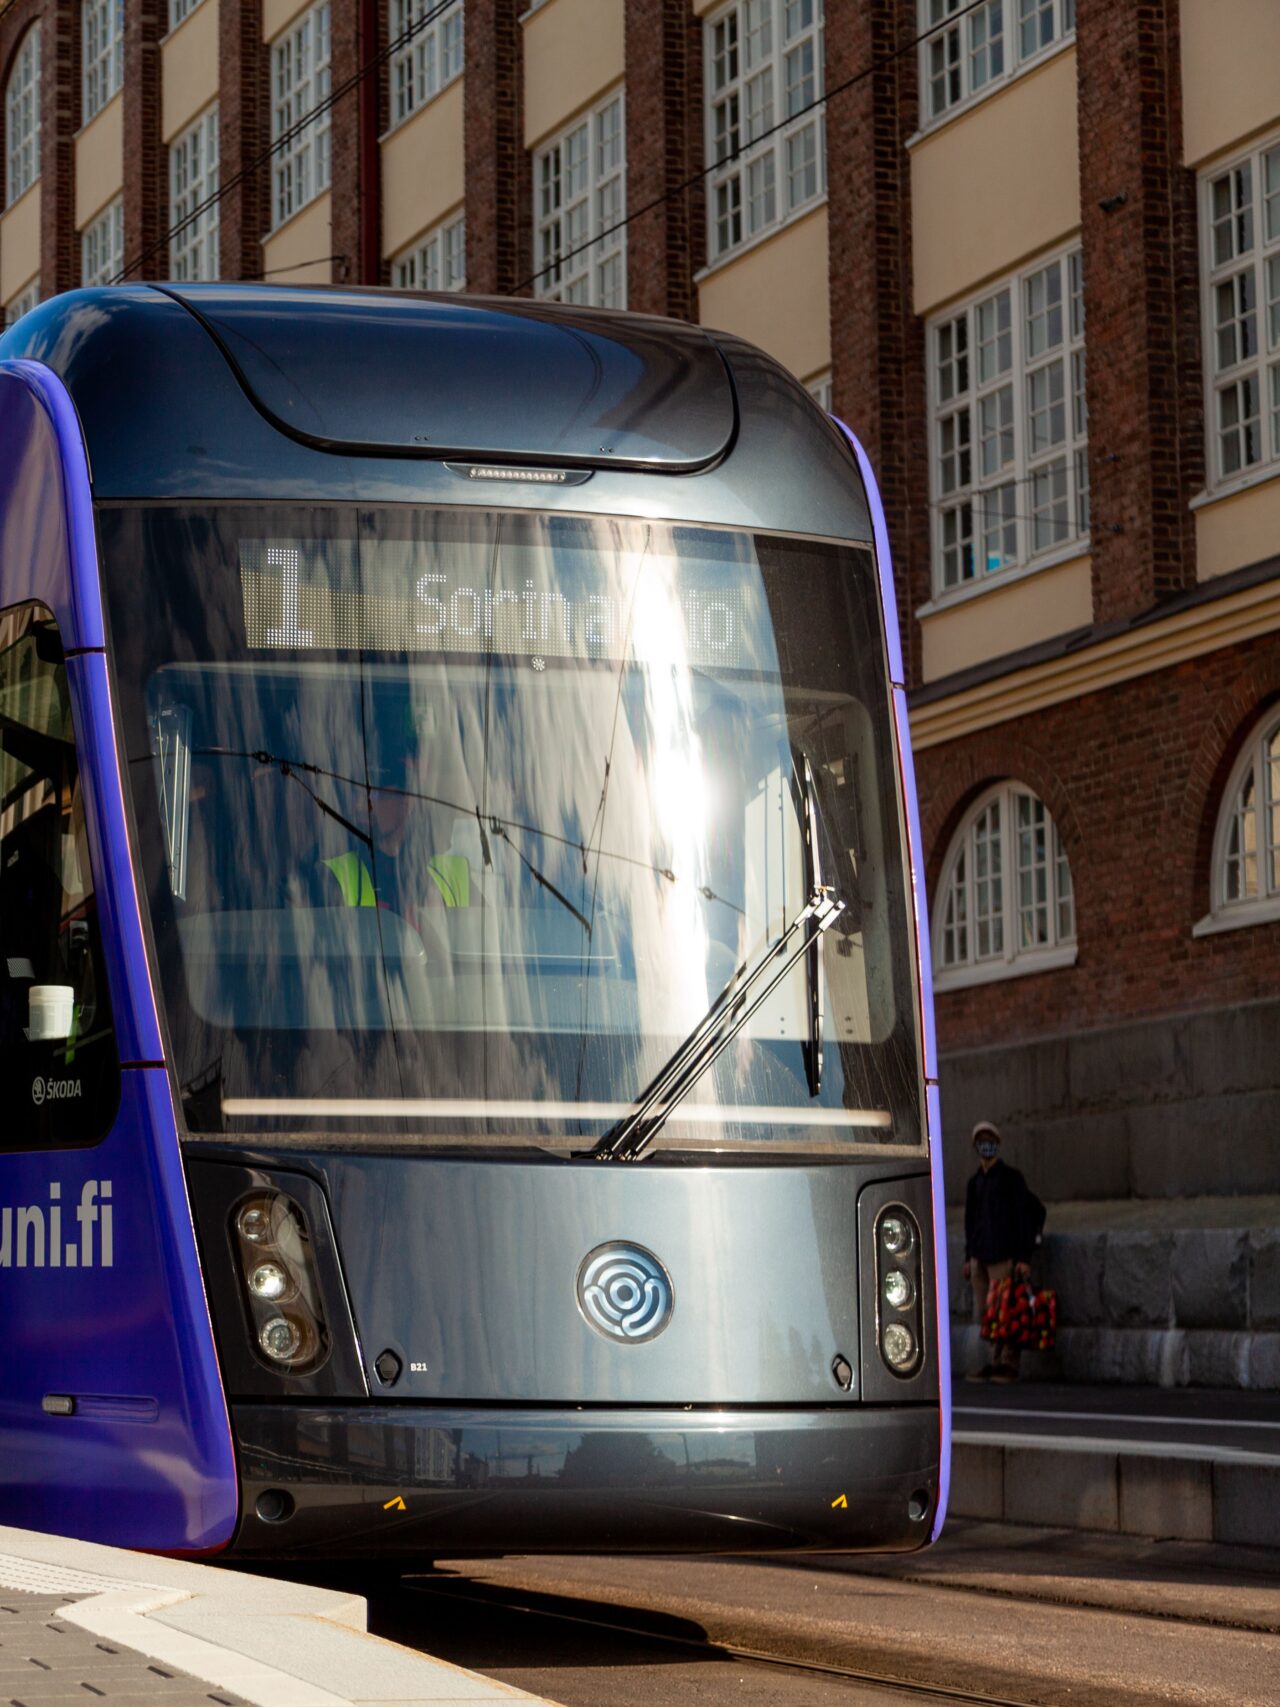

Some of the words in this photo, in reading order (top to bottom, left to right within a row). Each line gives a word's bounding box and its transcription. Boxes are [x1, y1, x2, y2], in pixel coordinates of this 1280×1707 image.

[267, 548, 313, 648] 1
[416, 573, 573, 643] Sorin
[586, 589, 733, 650] aio
[46, 1078, 82, 1099] ŠKODA
[410, 1362, 428, 1372] B21
